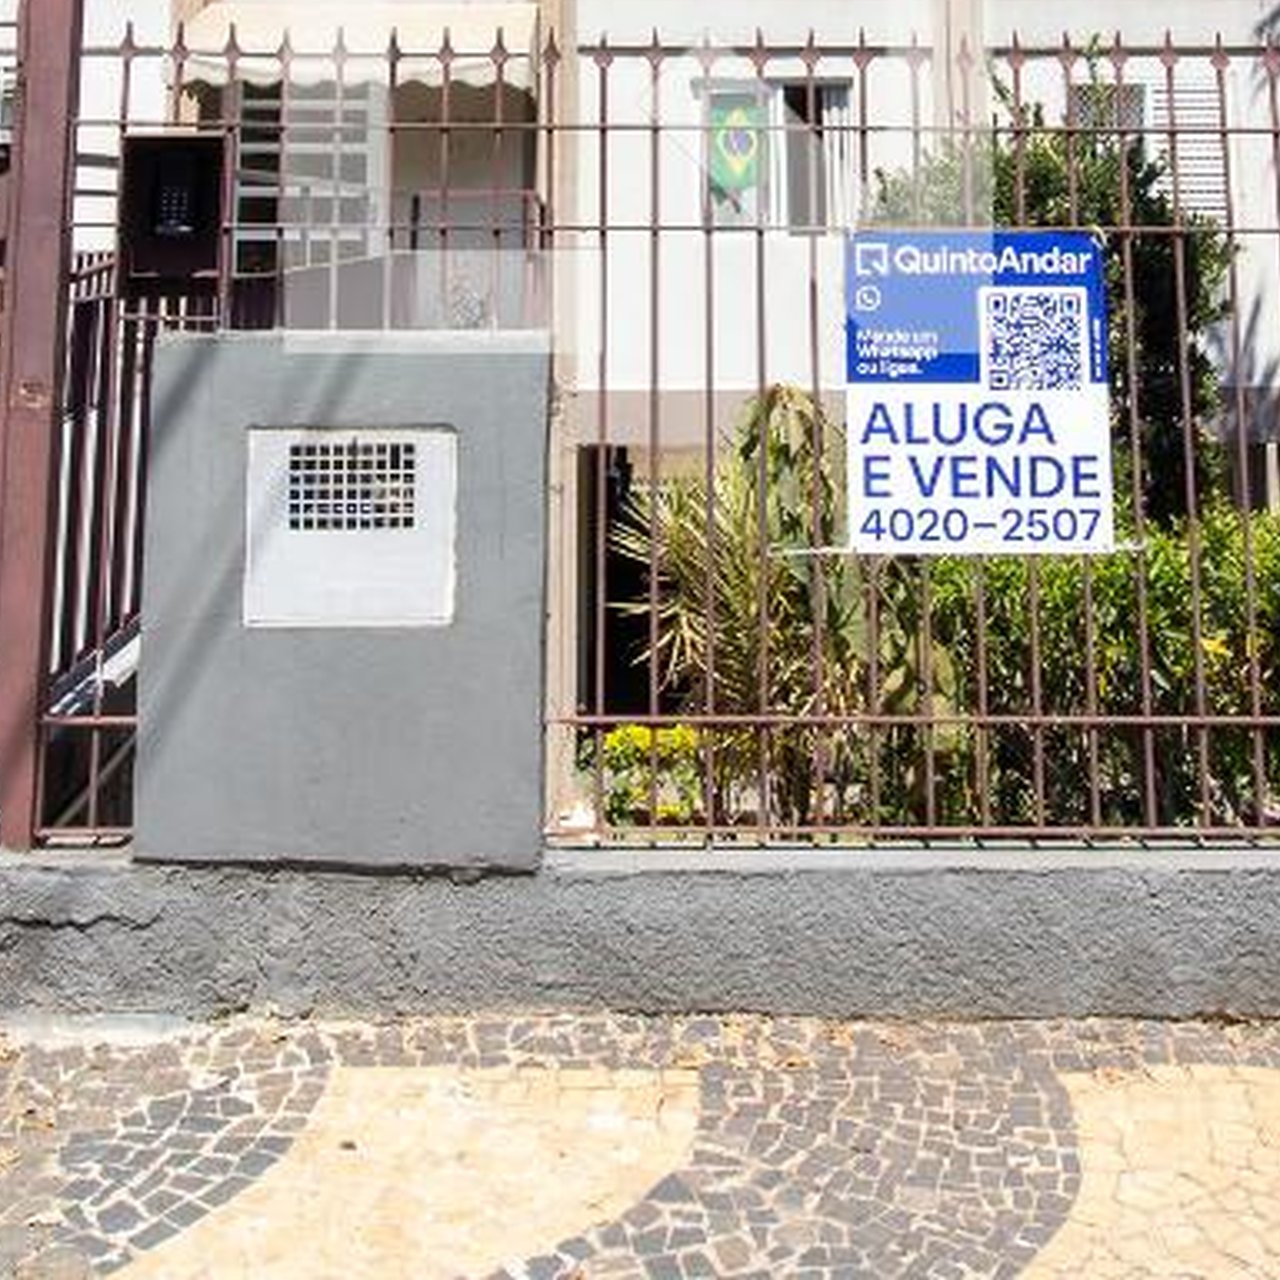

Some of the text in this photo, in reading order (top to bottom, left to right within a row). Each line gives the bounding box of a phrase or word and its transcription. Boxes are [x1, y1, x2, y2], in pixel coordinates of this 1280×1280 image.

[894, 246, 1092, 275] QuintoAndar
[859, 402, 1057, 446] ALUGA
[863, 455, 1101, 498] E VENDE
[859, 508, 1102, 542] 4020-2507
